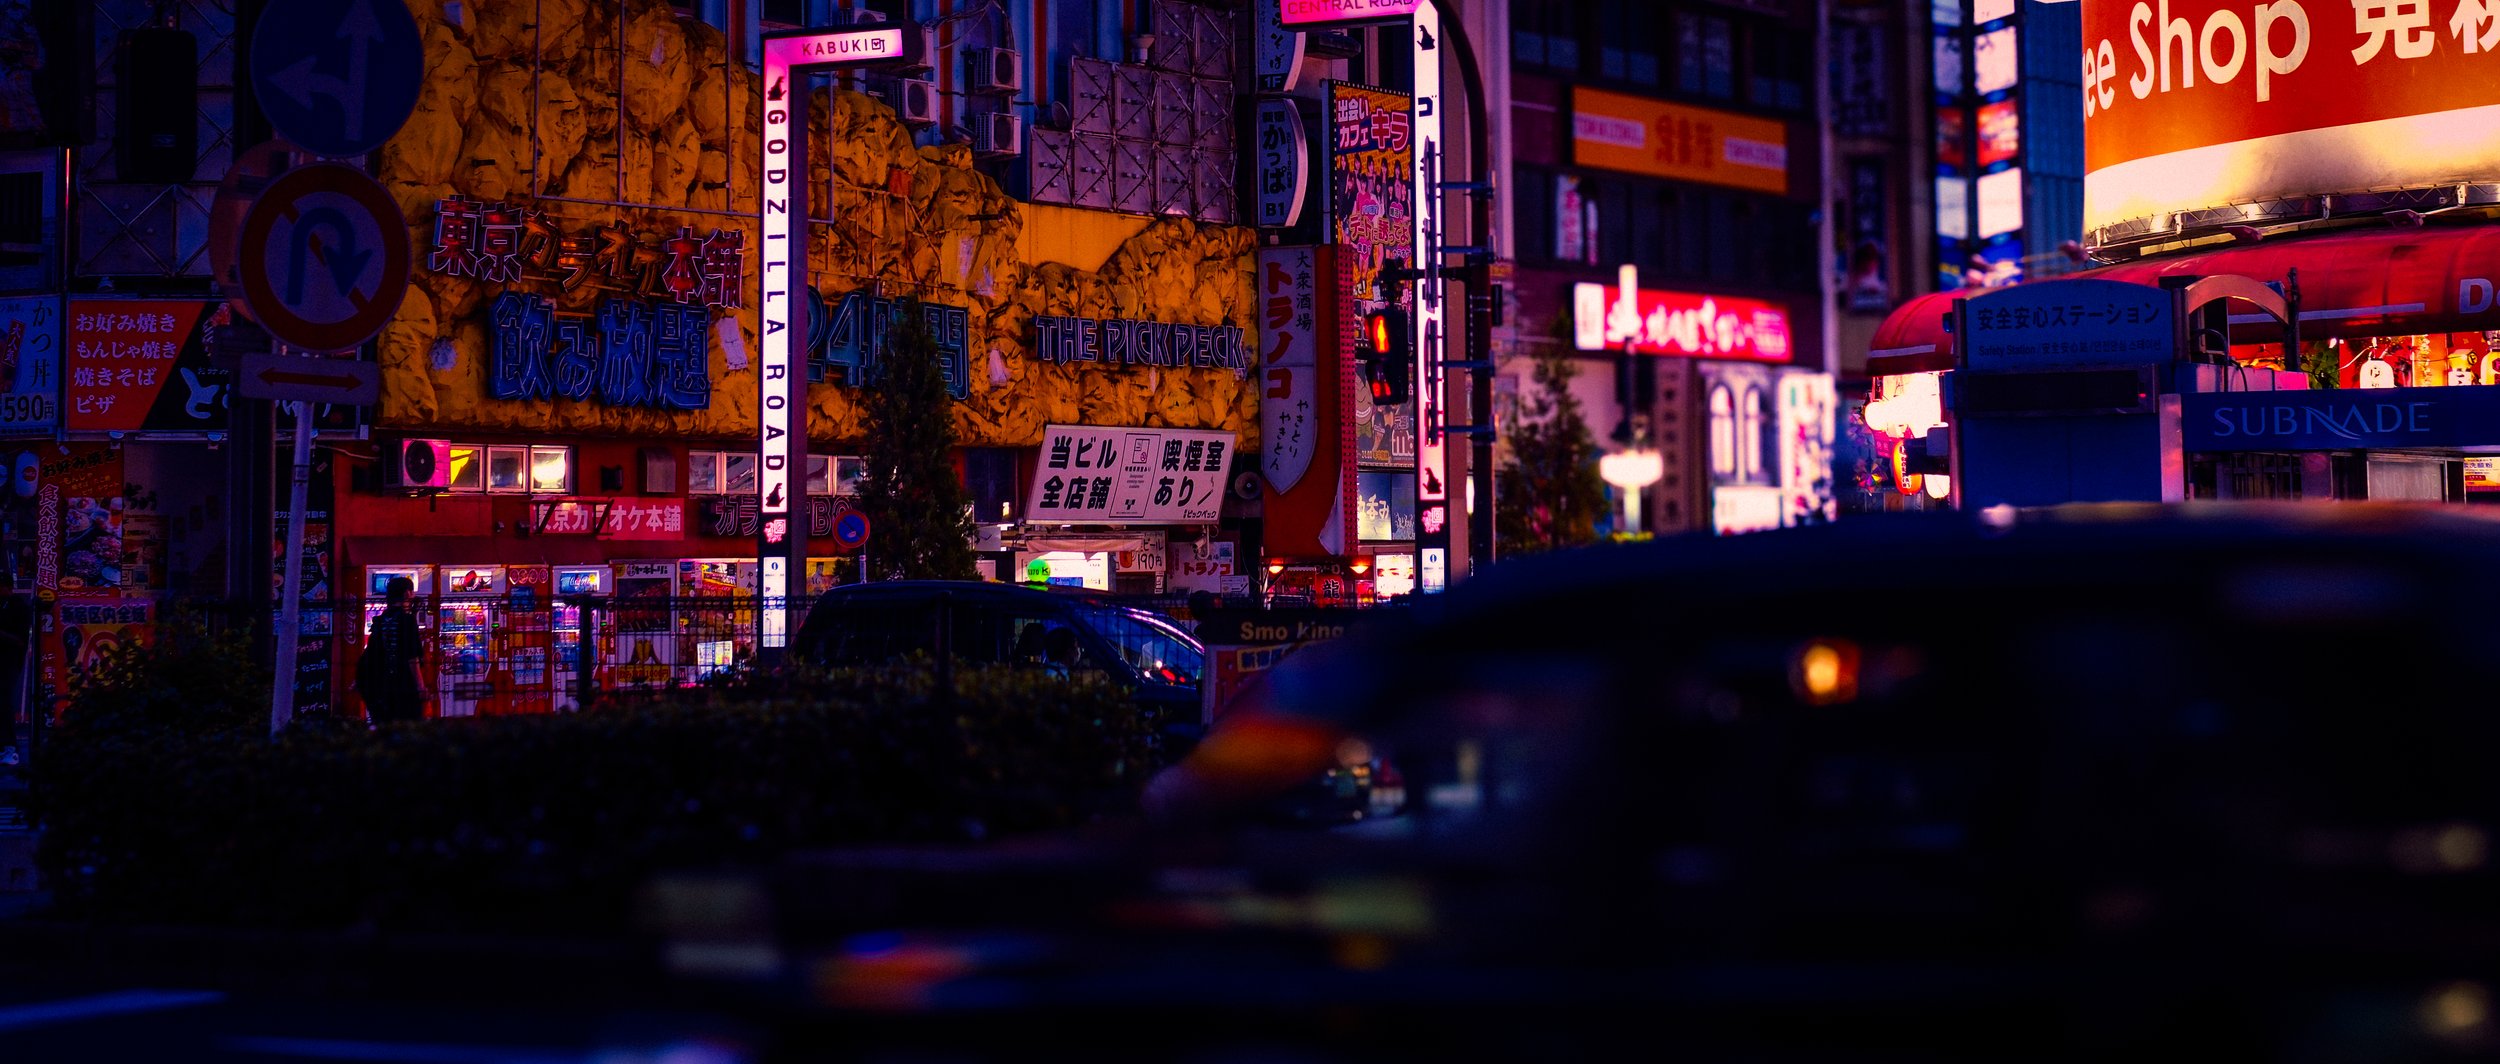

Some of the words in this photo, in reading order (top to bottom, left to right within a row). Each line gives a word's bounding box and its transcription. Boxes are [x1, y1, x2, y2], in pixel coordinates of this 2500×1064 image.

[2083, 38, 2116, 118] ee
[2129, 0, 2311, 103] Shop
[1264, 75, 1282, 88] 1F
[1338, 98, 1369, 122] 出会い
[1340, 125, 1368, 148] カフェ
[1371, 108, 1409, 152] キラ
[767, 109, 786, 334] GODZILLA
[1266, 203, 1285, 216] B1
[429, 195, 745, 308] 東京カラオケ本舗
[1296, 251, 1312, 332] 大衆酒場
[2459, 278, 2500, 314] D
[76, 313, 176, 333] お好み焼き
[1266, 262, 1294, 400] トラノコ
[1978, 303, 2160, 331] 安全安心ステーション
[31, 301, 52, 387] かつ丼
[77, 341, 177, 359] もんじゃ焼き
[490, 290, 710, 410] 飲み放題
[807, 284, 968, 400] 24間
[1035, 315, 1099, 366] THE
[74, 367, 157, 387] 焼きそば
[76, 395, 115, 414] ピザ
[766, 364, 785, 471] ROAD
[2213, 401, 2438, 441] SUBNADE
[1270, 411, 1291, 471] やきとん
[1289, 400, 1308, 457] やきとり
[1049, 436, 1117, 469] 当ビル
[1161, 439, 1225, 472] 喫煙室
[1040, 475, 1112, 510] 全店舗
[38, 484, 59, 590] 食べ飲み放題
[1138, 553, 1163, 570] 190円
[1184, 562, 1230, 576] トラノコ
[1323, 579, 1340, 600] 龍
